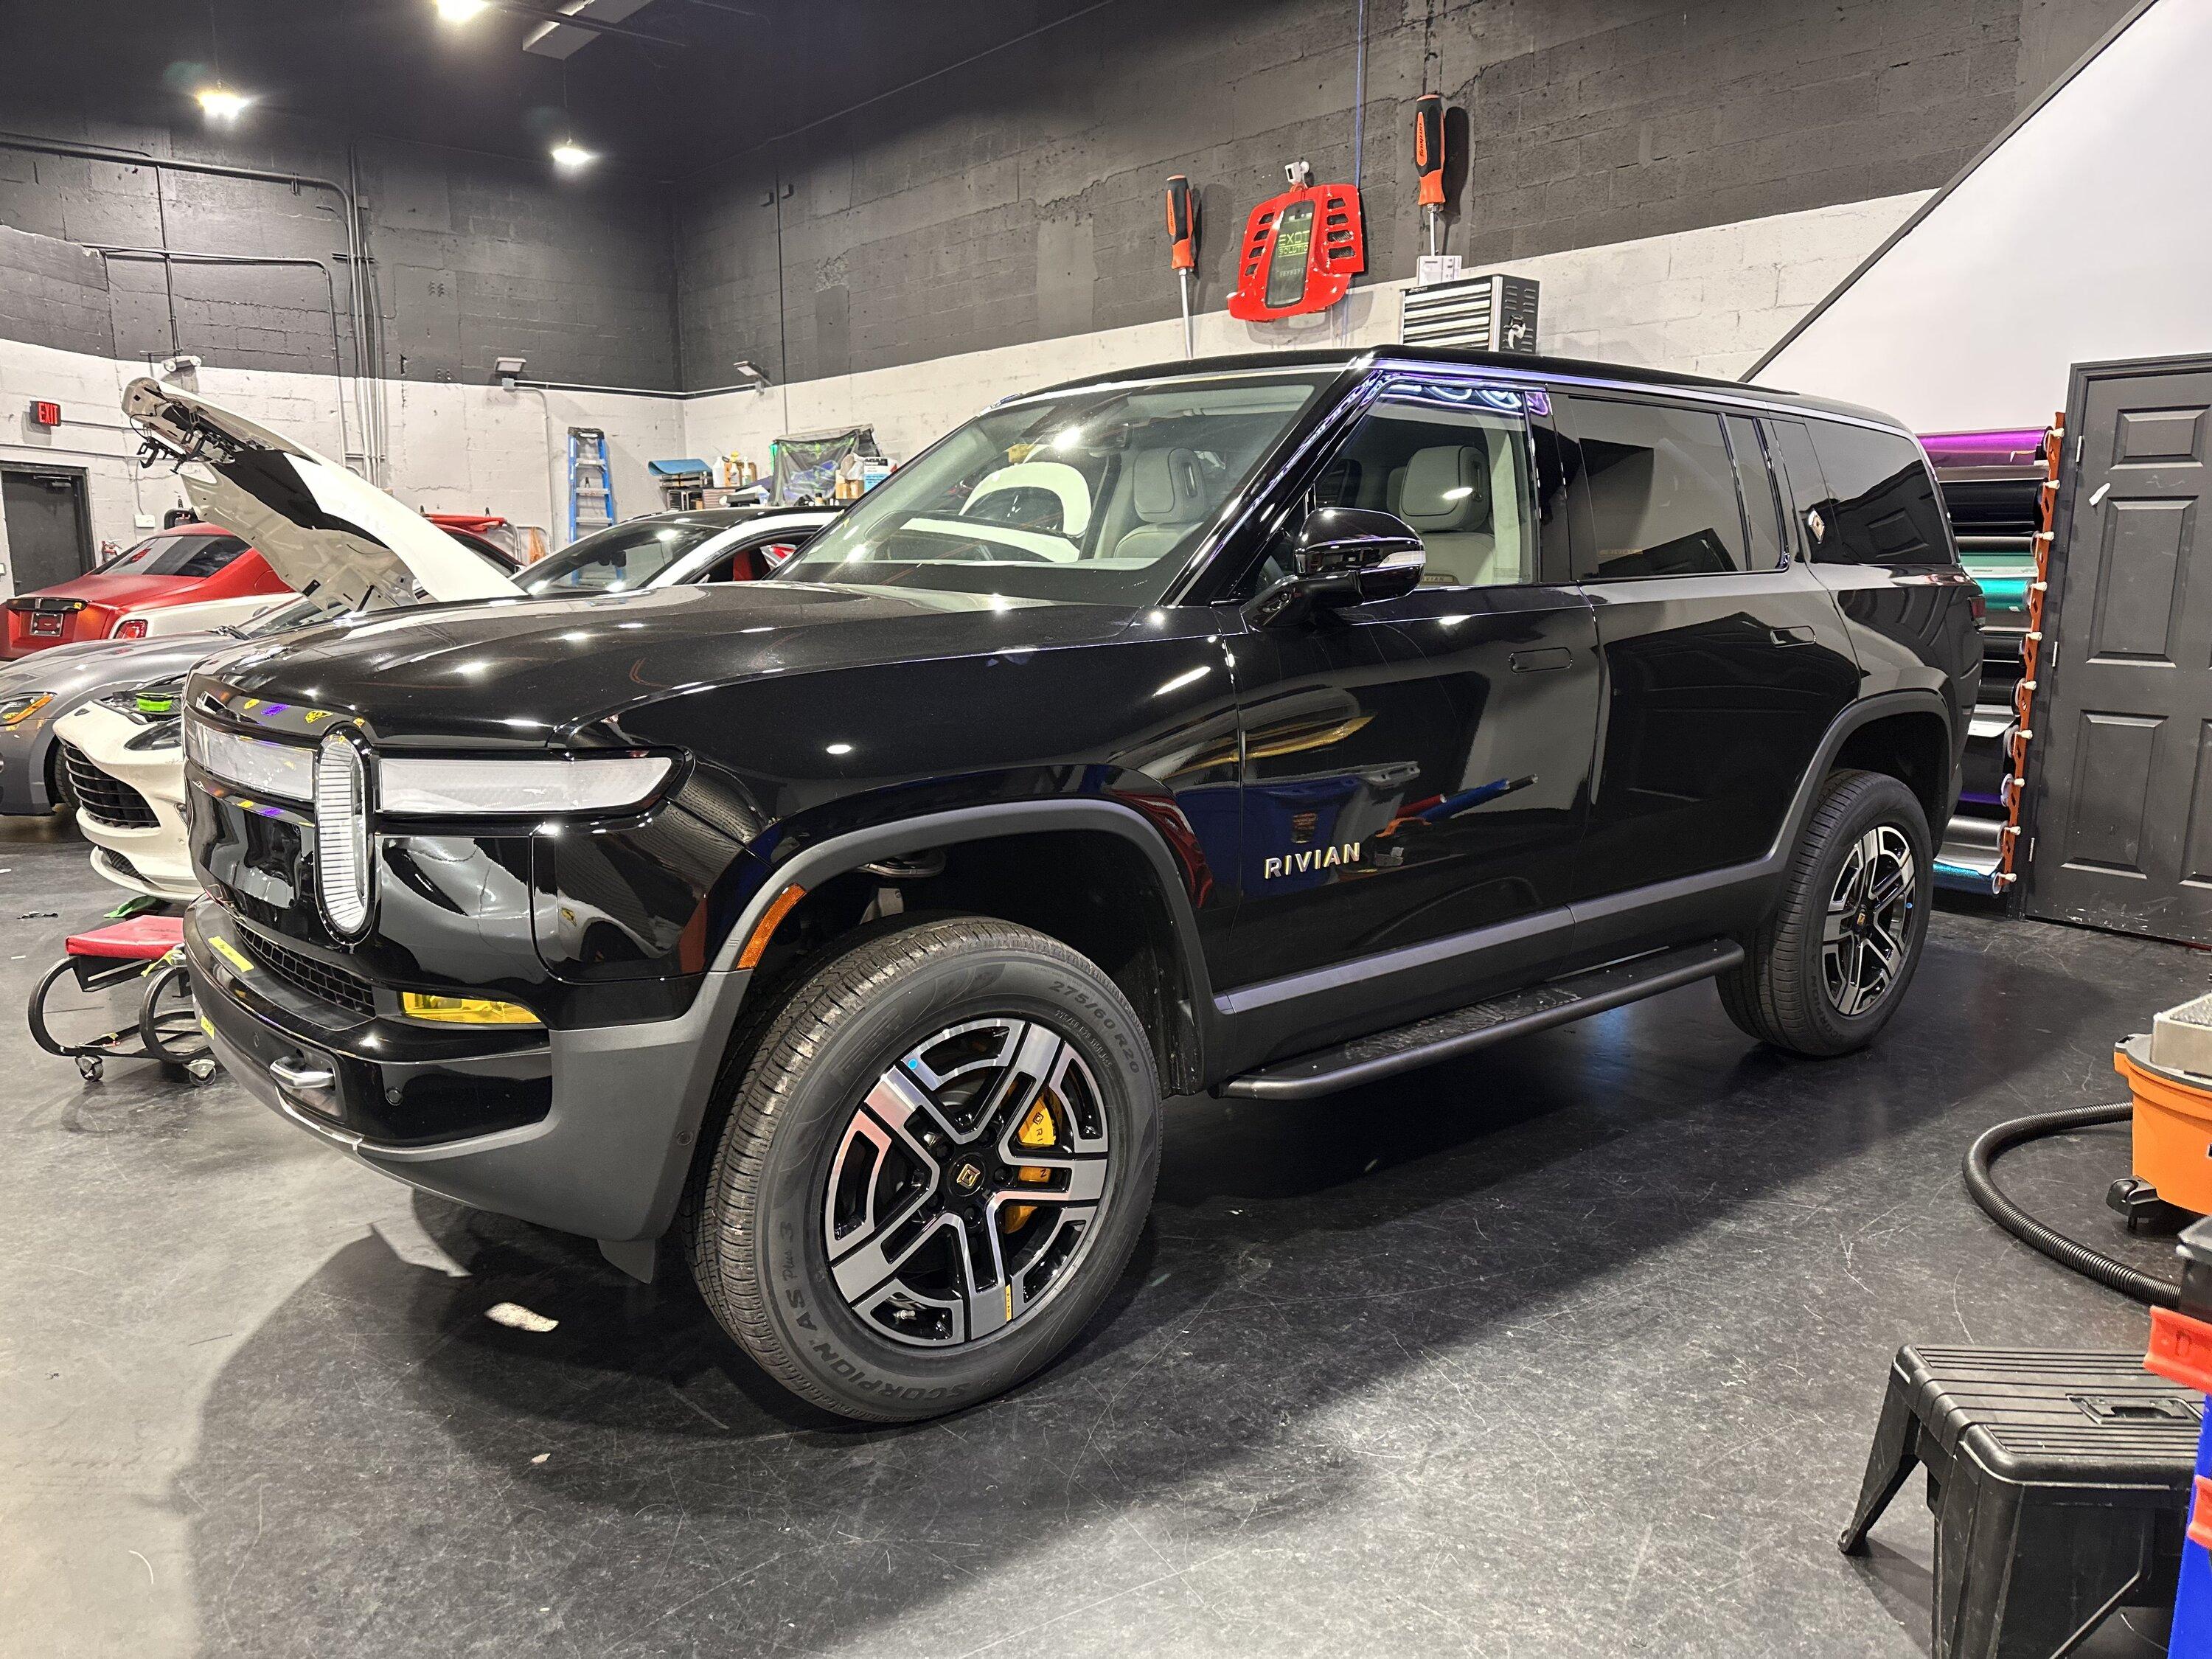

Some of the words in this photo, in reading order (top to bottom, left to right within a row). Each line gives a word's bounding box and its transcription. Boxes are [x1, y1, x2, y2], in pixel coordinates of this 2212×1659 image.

[38, 402, 58, 425] EXIT
[1264, 842, 1360, 880] RIVIAN
[1048, 981, 1116, 1029] 275/60
[1115, 1033, 1140, 1074] R20
[785, 1289, 818, 1331] AS
[813, 1343, 970, 1399] SCORPION
